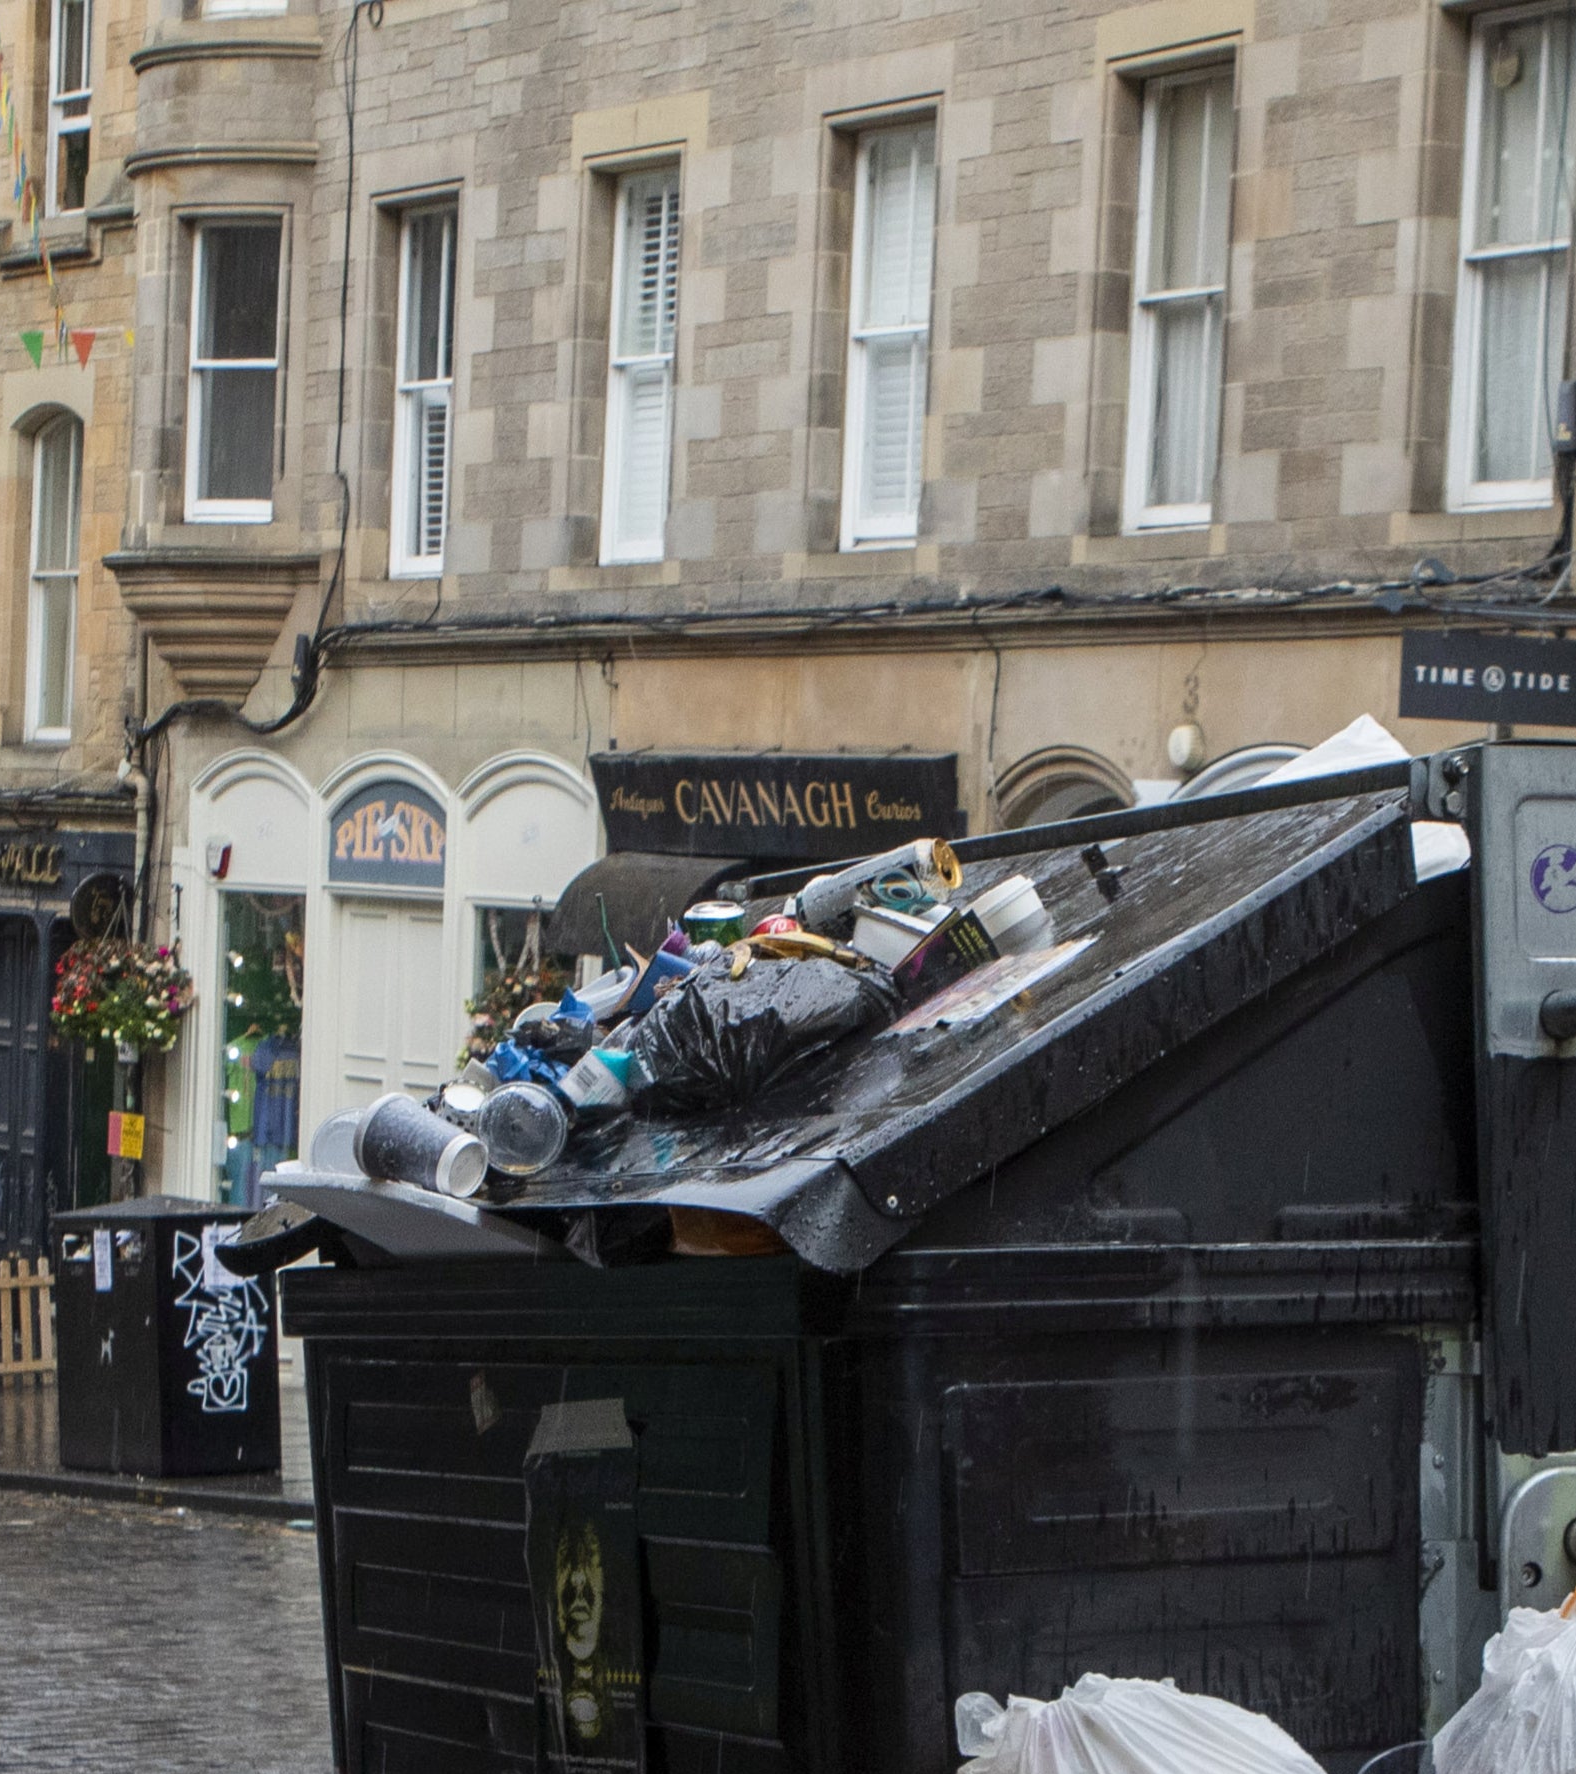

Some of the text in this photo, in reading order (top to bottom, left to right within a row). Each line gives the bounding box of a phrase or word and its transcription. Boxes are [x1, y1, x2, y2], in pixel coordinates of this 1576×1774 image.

[1415, 664, 1476, 687] TIME
[1512, 670, 1571, 693] TIDE
[674, 779, 857, 829] CAVANAGH
[864, 789, 922, 821] Curios
[335, 802, 386, 860] PIE
